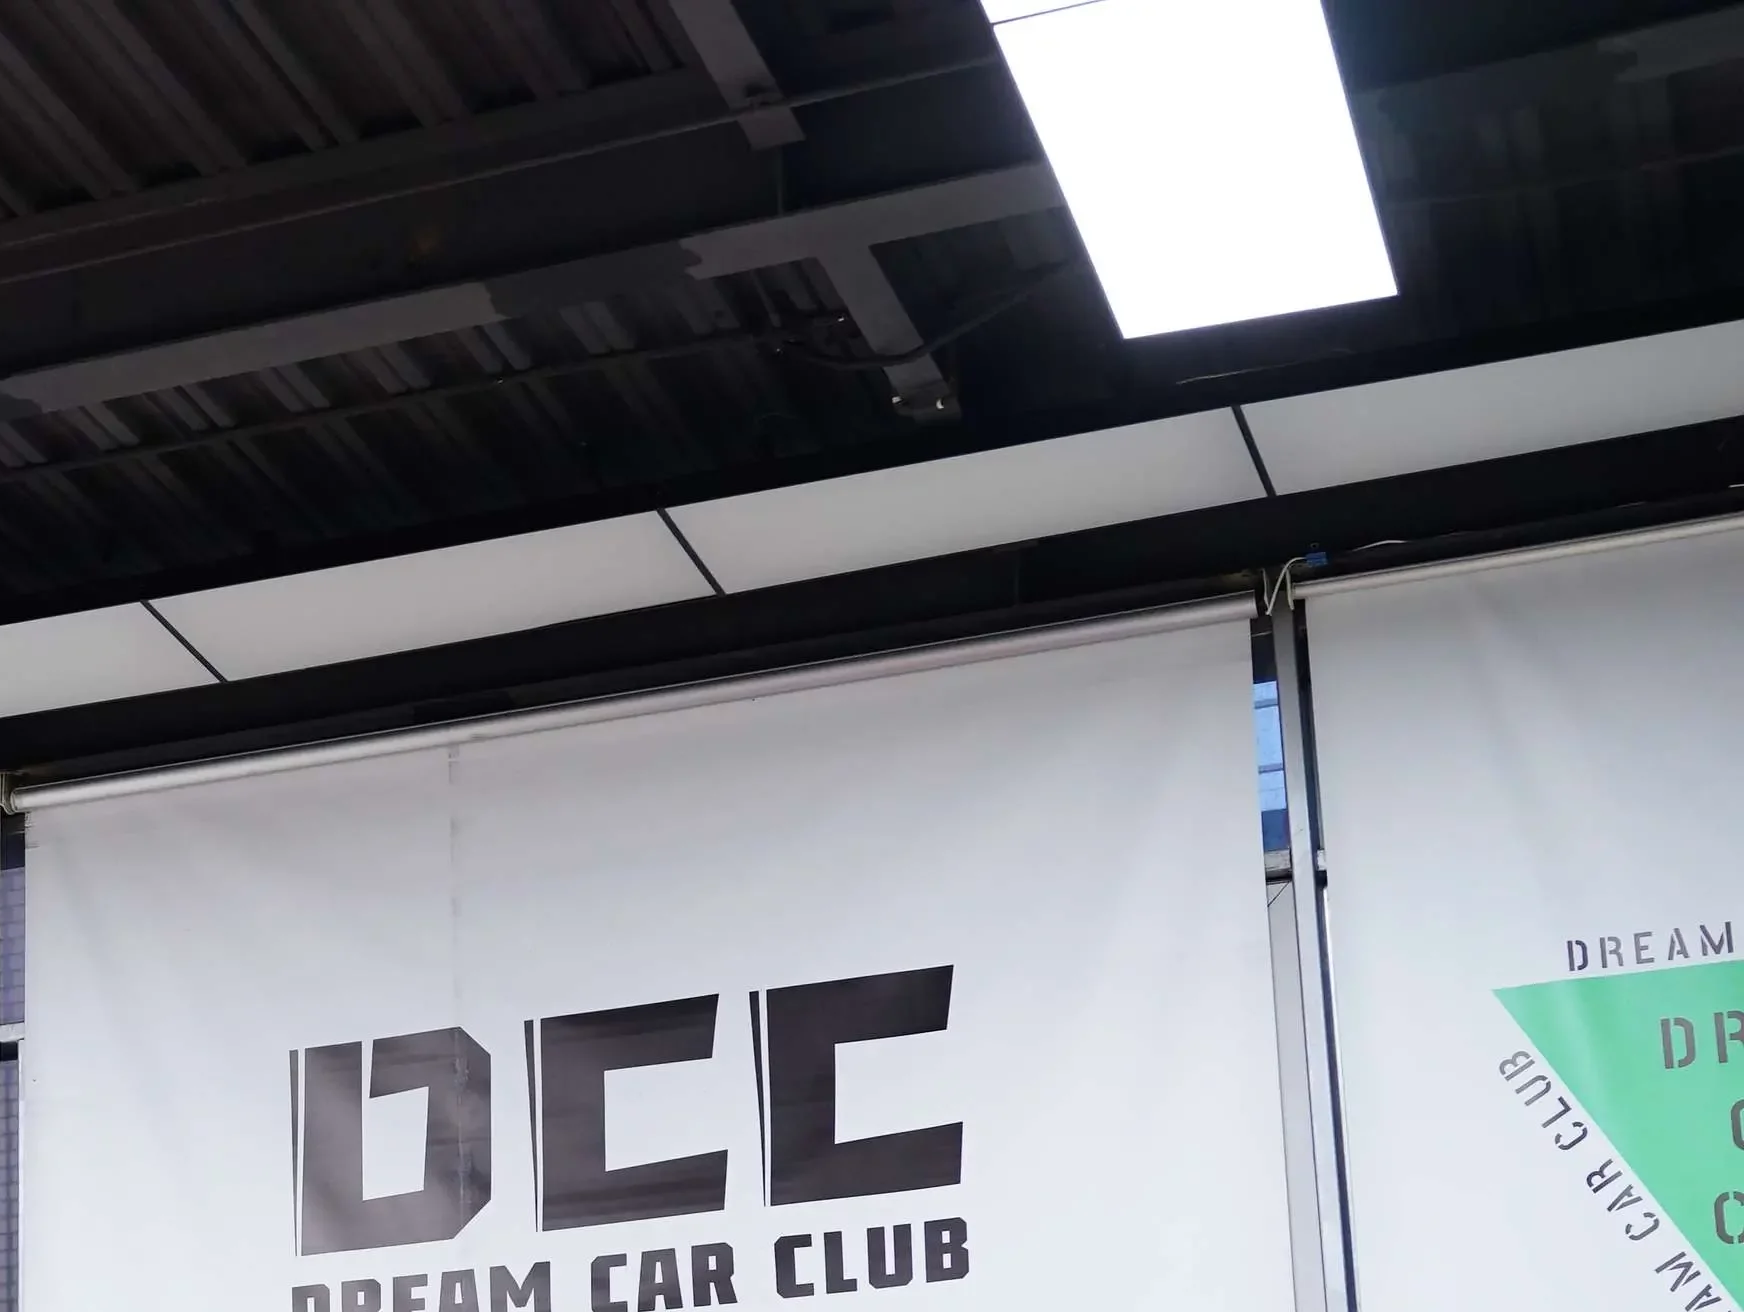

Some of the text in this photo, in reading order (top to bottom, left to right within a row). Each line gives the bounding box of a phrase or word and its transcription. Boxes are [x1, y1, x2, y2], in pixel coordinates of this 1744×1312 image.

[1567, 921, 1734, 972] DREAM
[289, 964, 963, 1257] DCC
[1498, 1050, 1589, 1151] CLUB
[1586, 1158, 1660, 1242] CAR
[774, 1216, 969, 1299] CLUB
